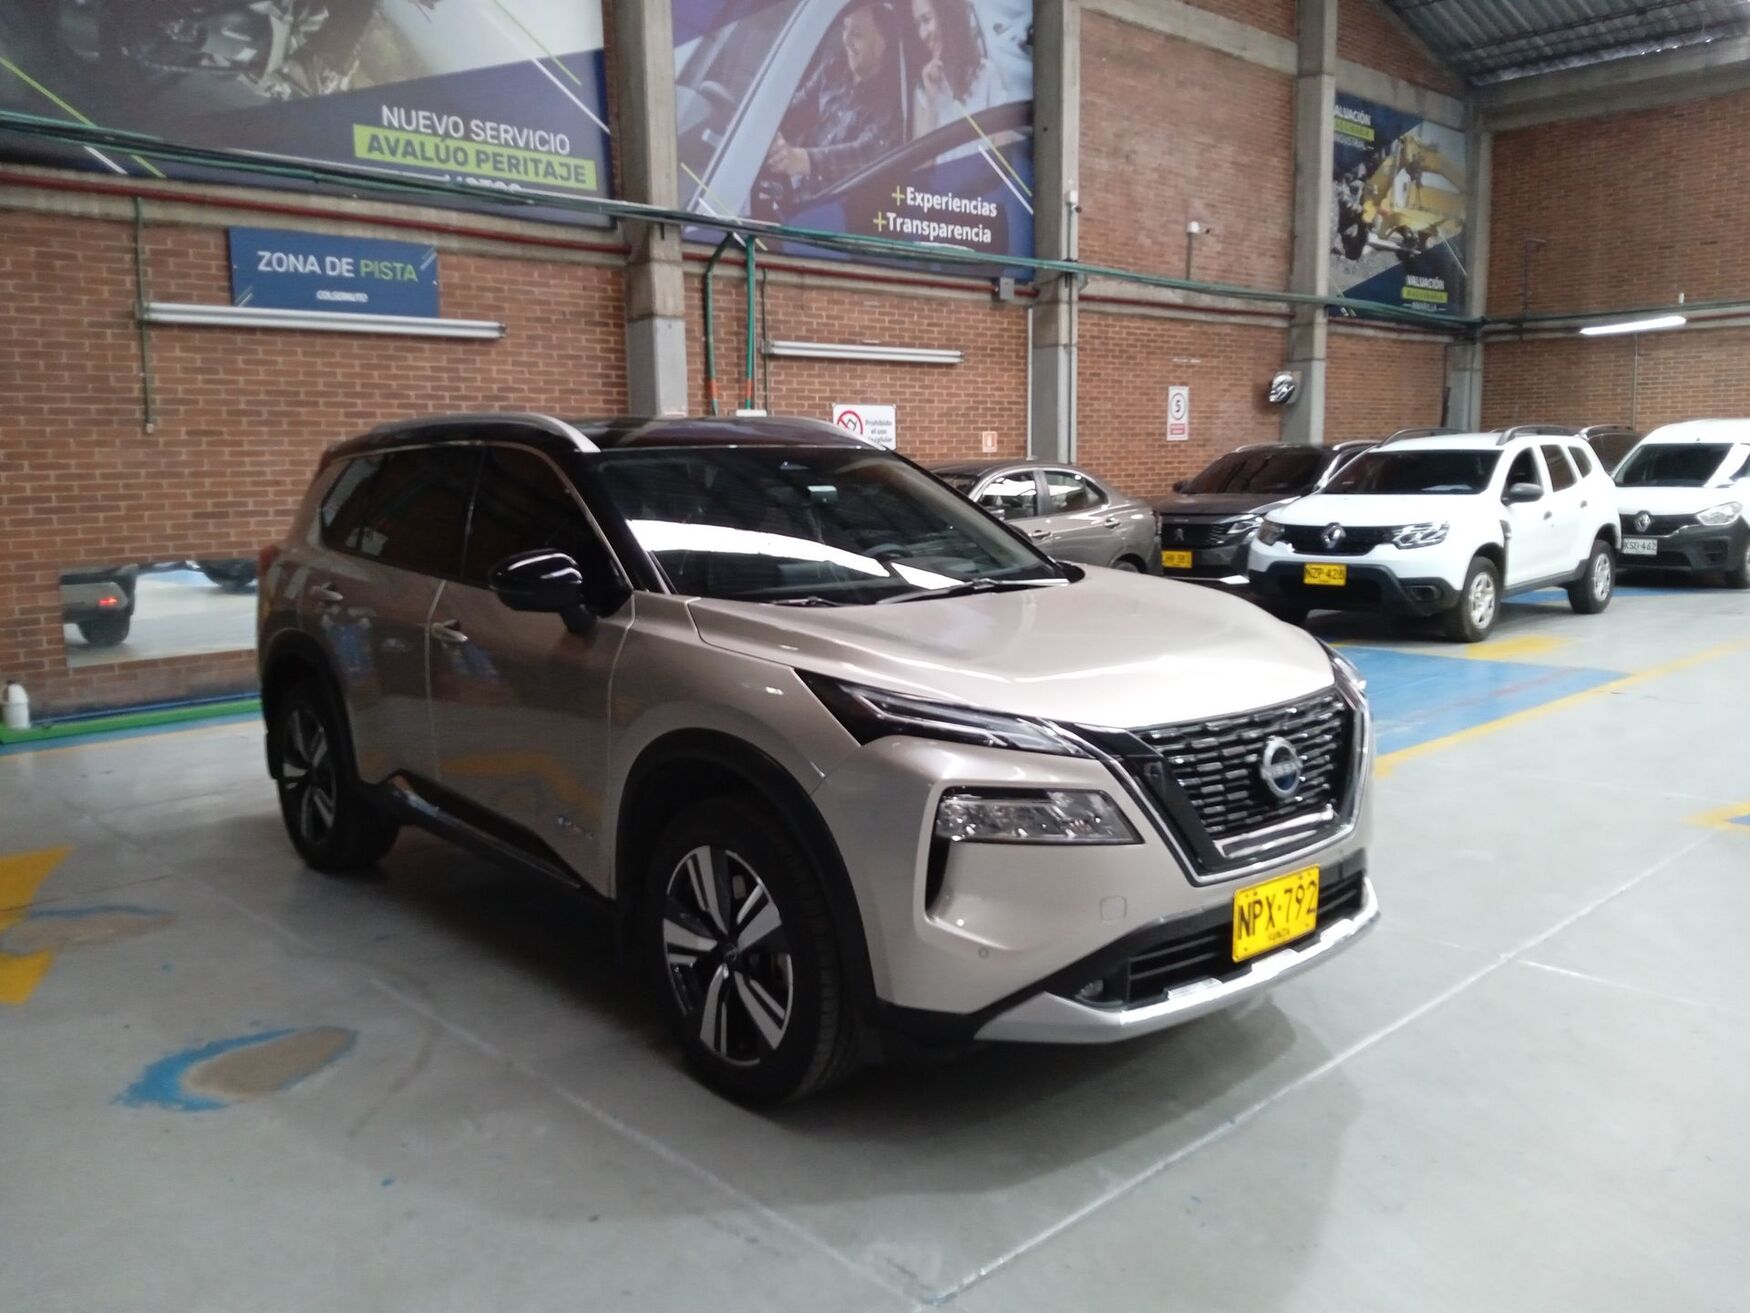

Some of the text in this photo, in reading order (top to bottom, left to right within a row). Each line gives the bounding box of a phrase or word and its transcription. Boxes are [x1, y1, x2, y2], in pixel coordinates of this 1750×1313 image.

[381, 104, 571, 155] NUEVO SERVICIO
[366, 133, 469, 167] AVALÚO
[474, 147, 587, 184] PERITAJE
[256, 250, 418, 282] ZONA DE PISTA
[1174, 399, 1182, 413] 5
